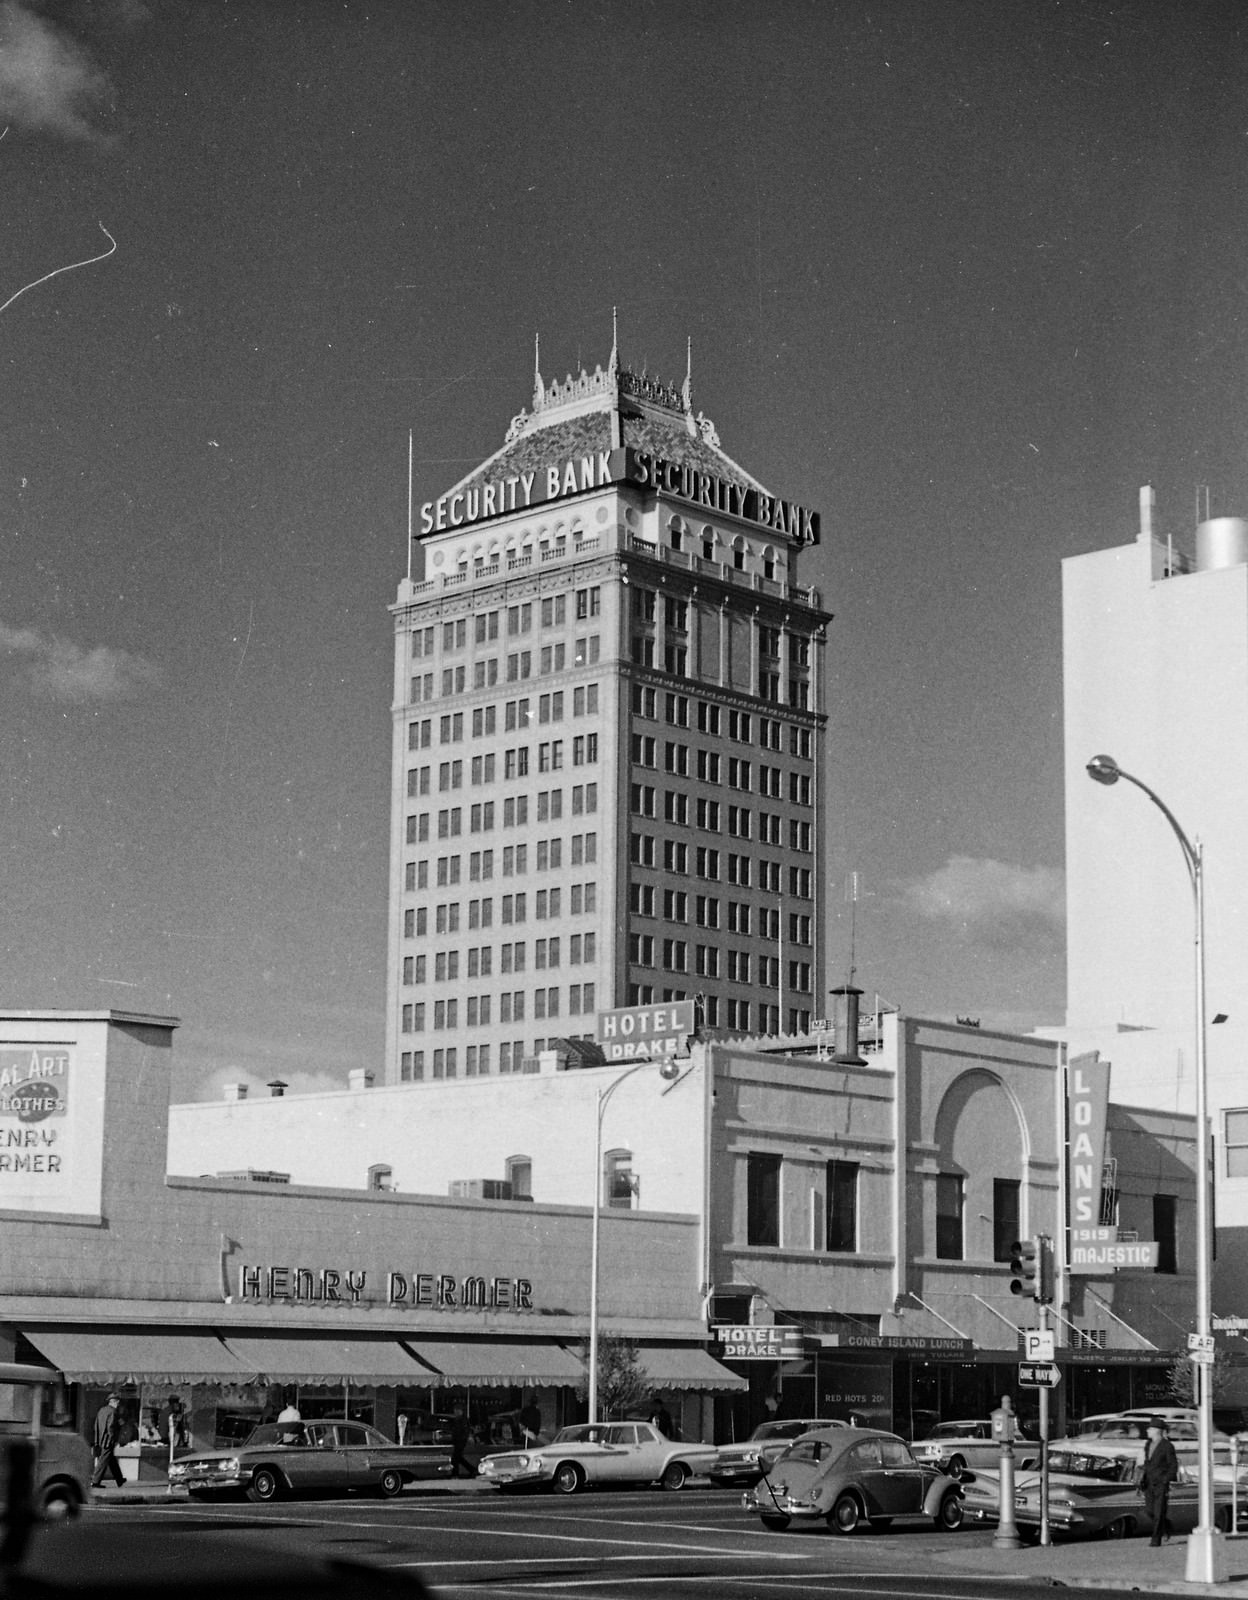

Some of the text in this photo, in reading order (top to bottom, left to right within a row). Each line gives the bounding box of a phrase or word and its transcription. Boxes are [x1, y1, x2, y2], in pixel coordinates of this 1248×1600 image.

[421, 450, 612, 535] SECURITY BANK
[634, 450, 815, 544] SECURITY BANK
[604, 1009, 684, 1037] HOTEL
[612, 1038, 677, 1058] DRAKE
[28, 1050, 67, 1078] ART
[0, 1098, 64, 1111] LOTHES
[1073, 1070, 1094, 1221] LOANS
[1073, 1229, 1109, 1241] 1919
[1073, 1246, 1150, 1263] MAJESTIC
[239, 1265, 533, 1307] HENRY DERMER
[718, 1329, 781, 1342] HOTEL
[849, 1336, 964, 1350] CONEY ISLAND LUNCH
[725, 1345, 776, 1355] DRAKE
[1030, 1336, 1040, 1355] P
[1020, 1368, 1050, 1381] ONE WAY
[825, 1394, 841, 1402] RED
[844, 1394, 866, 1403] HOTS
